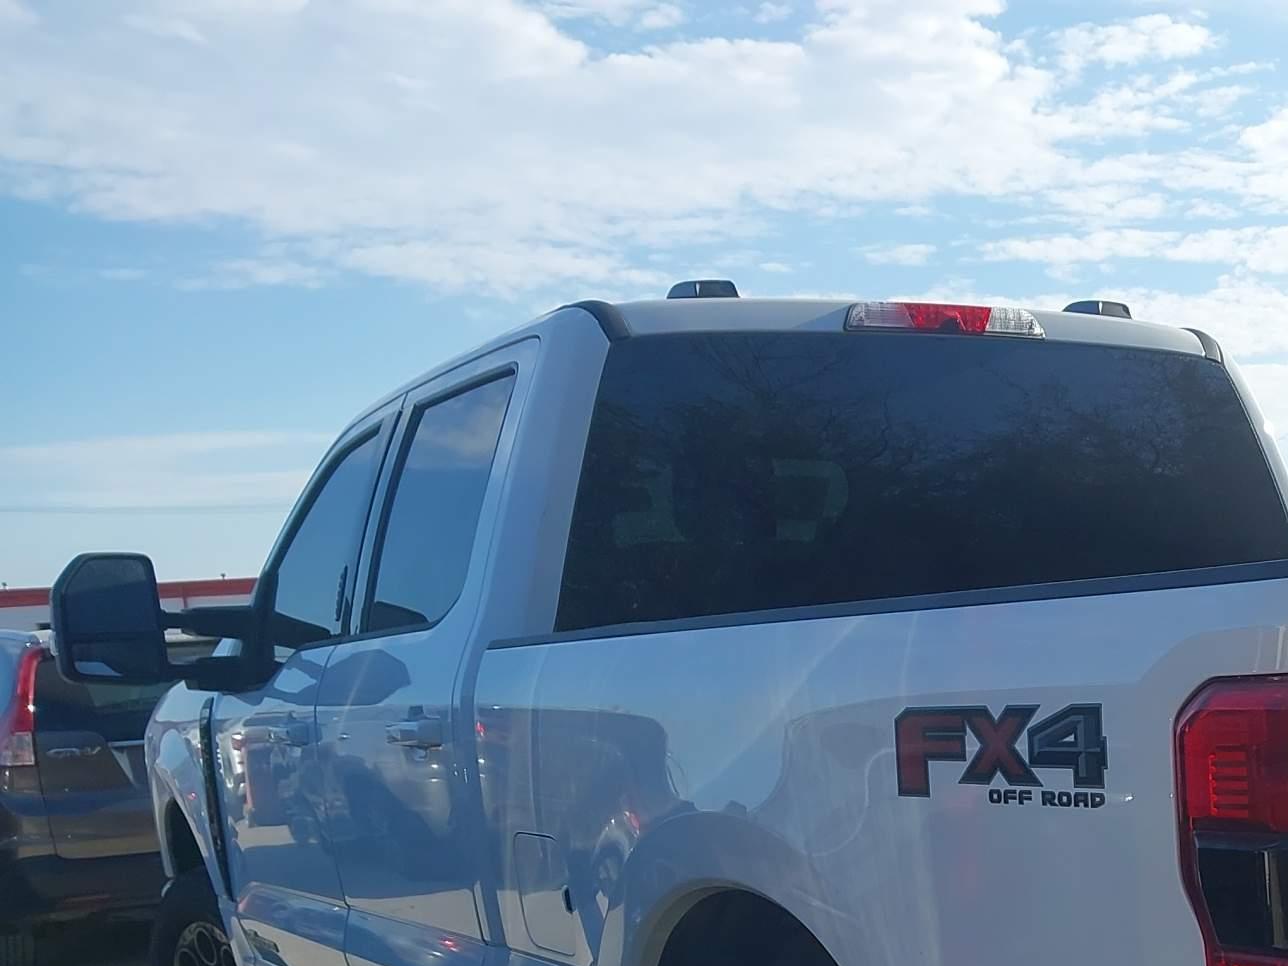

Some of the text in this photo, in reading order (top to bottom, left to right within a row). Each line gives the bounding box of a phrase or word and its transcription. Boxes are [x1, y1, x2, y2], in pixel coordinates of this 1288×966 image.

[894, 703, 1108, 797] FX4
[988, 789, 1106, 809] OFF ROAD
